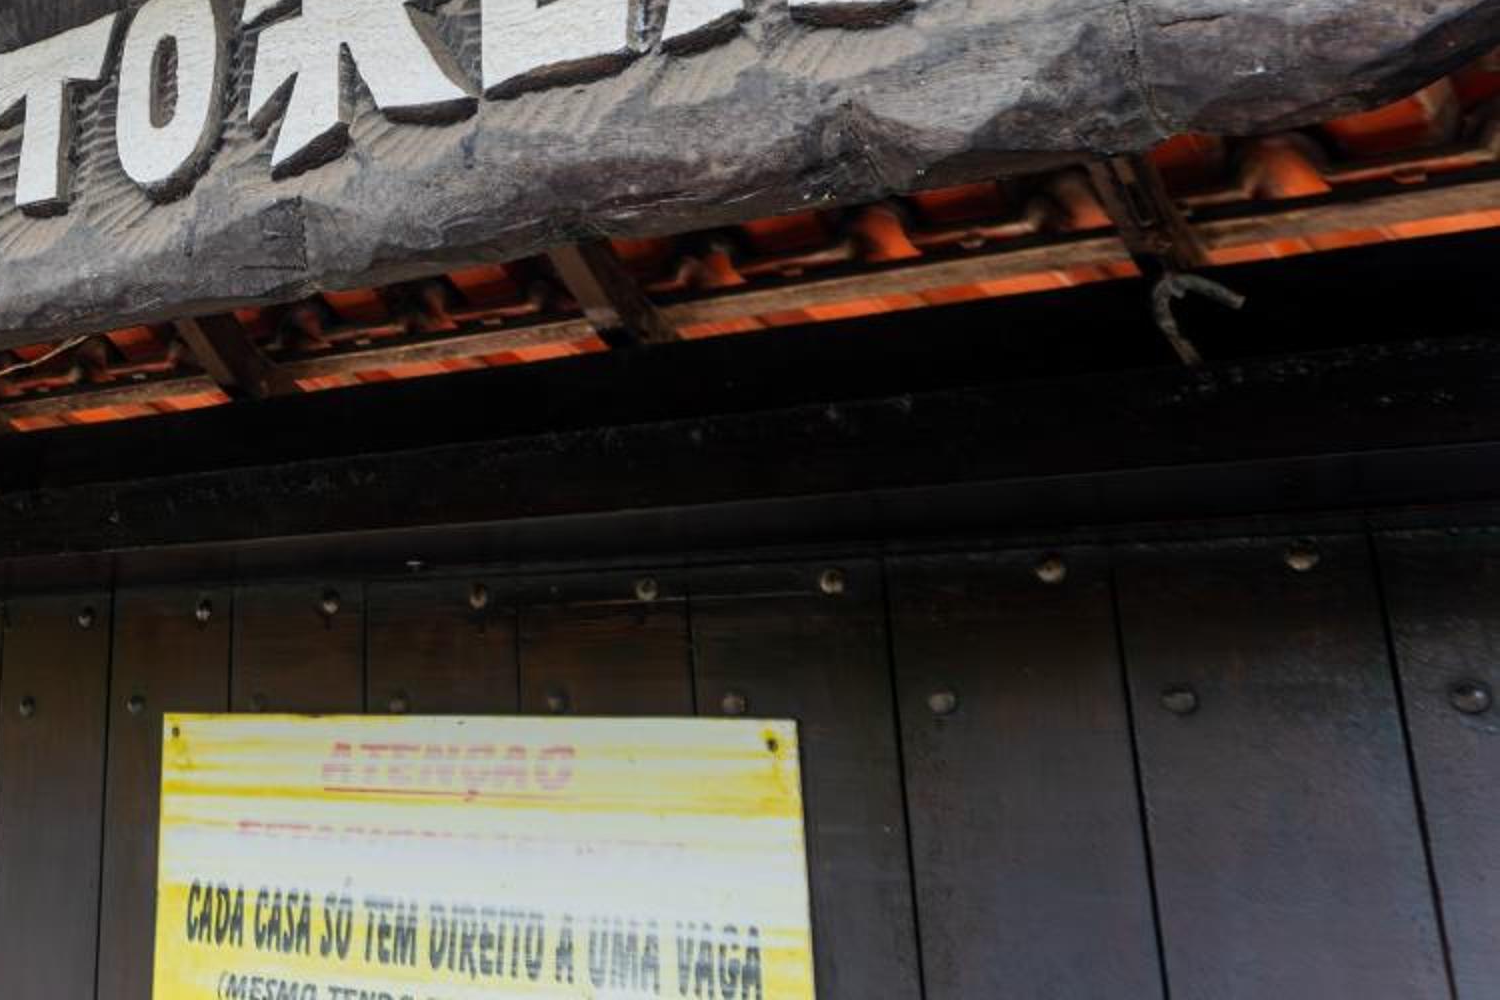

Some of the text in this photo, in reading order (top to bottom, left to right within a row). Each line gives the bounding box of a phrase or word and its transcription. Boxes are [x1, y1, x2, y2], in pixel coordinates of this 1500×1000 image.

[186, 879, 244, 948] CADA
[254, 885, 311, 957] CASA
[363, 896, 418, 967] TEM
[429, 903, 545, 982] DIREITO
[555, 912, 575, 985] A
[588, 914, 661, 995] UMA
[675, 920, 763, 1000] VAGA
